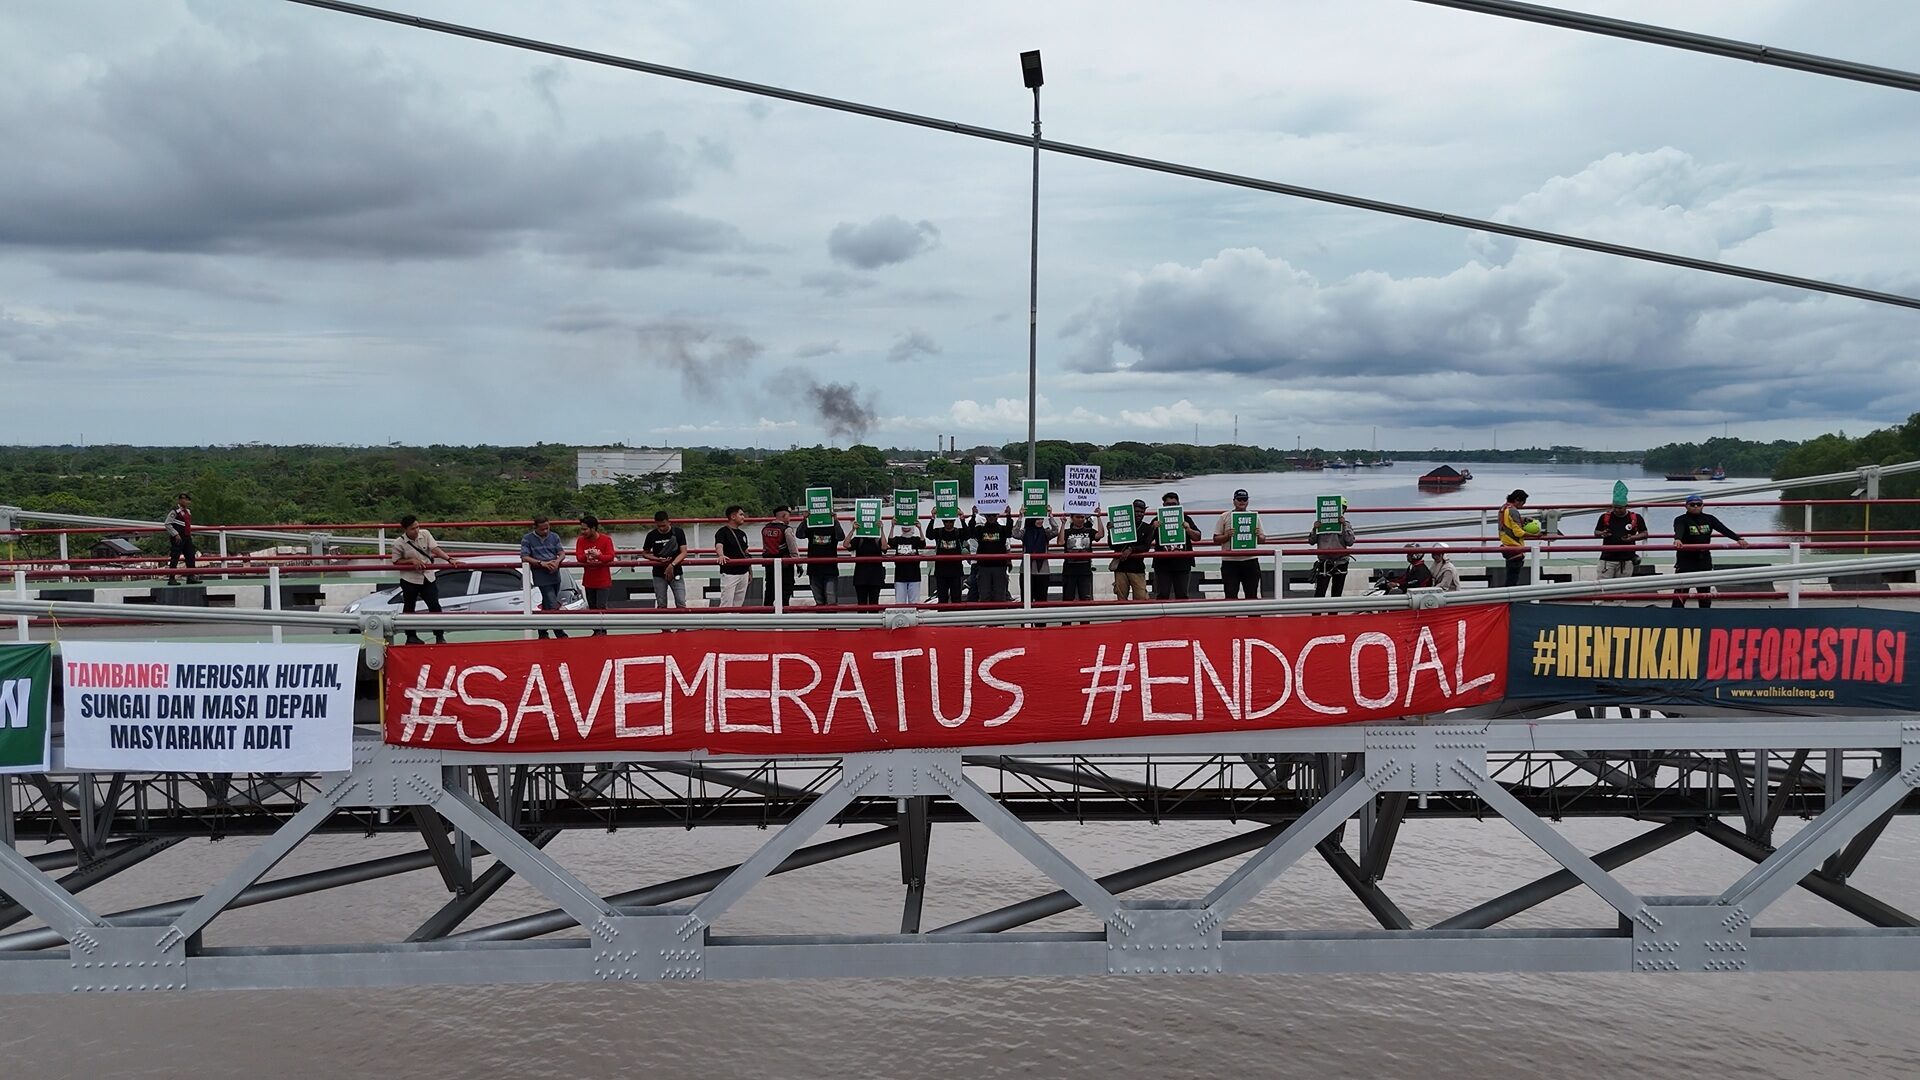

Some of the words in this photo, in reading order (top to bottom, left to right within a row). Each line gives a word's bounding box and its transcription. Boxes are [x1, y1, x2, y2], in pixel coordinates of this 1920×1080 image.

[984, 483, 999, 491] AIR
[1238, 517, 1251, 525] SAVE
[1239, 525, 1251, 533] OUR
[1532, 625, 1701, 680] #HENTIKAN
[1706, 627, 1907, 684] DEFORESTASI
[67, 662, 169, 689] TAMBANG!
[176, 663, 270, 689] MERUSAK
[276, 663, 342, 691] HUTAN,
[401, 647, 1026, 745] #SAVEMERATUS
[1080, 620, 1495, 726] #ENDCOAL
[1730, 686, 1835, 699] www.walhikalteng.org
[81, 693, 151, 719] SUNGAI
[157, 694, 195, 720] DAN
[202, 694, 259, 720] MASA
[265, 693, 328, 719] DEPAN
[110, 724, 238, 750] MASYARAKAT
[243, 724, 294, 750] ADAT
